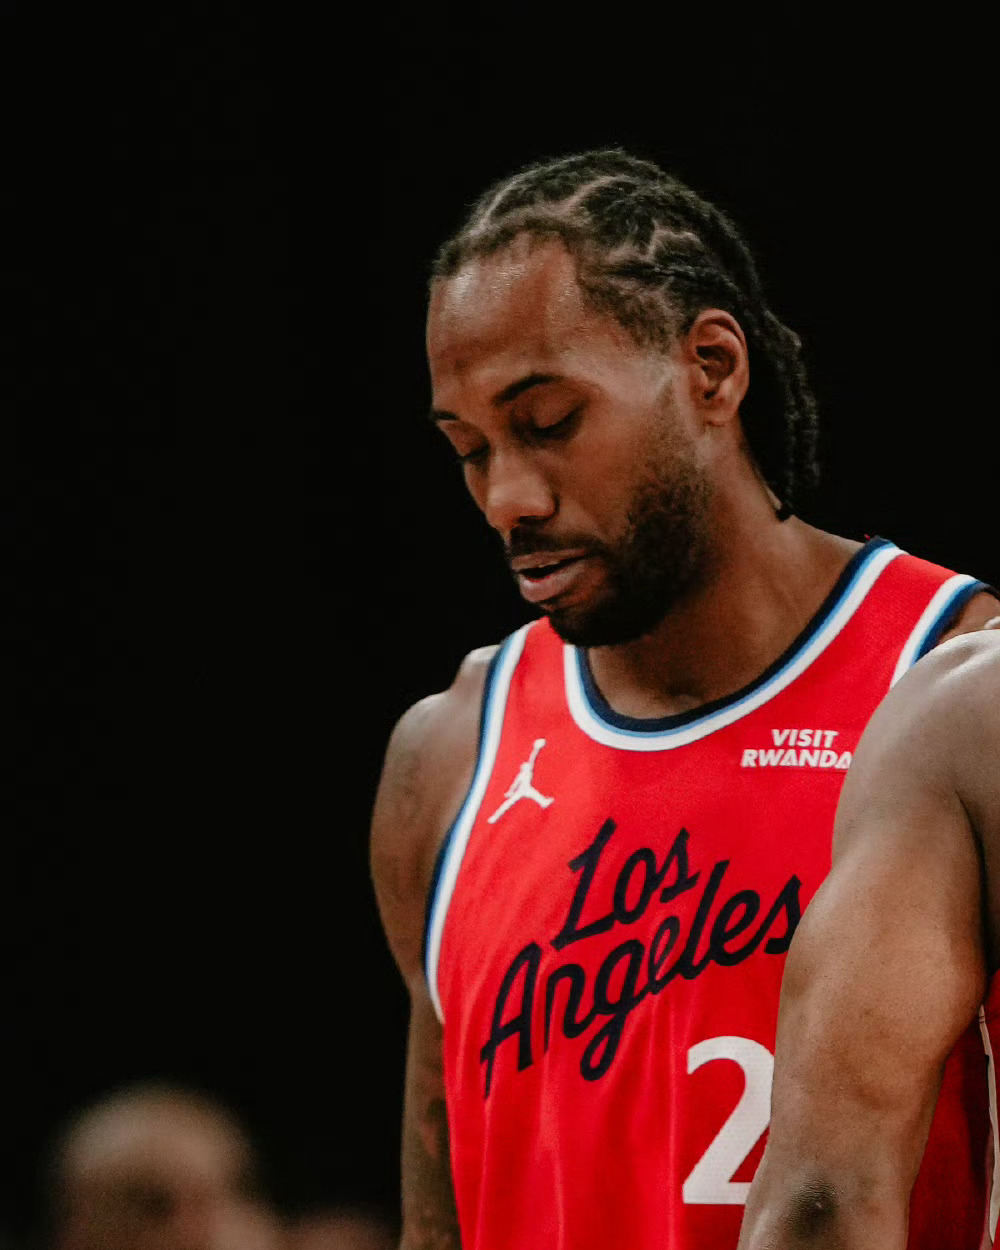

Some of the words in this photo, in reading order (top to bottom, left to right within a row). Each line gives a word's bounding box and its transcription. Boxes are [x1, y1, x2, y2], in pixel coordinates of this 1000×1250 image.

[740, 748, 853, 770] RWANDA
[771, 728, 839, 749] VISIT
[550, 818, 701, 951] Los
[479, 859, 803, 1099] Angeles
[682, 1035, 775, 1205] 2
